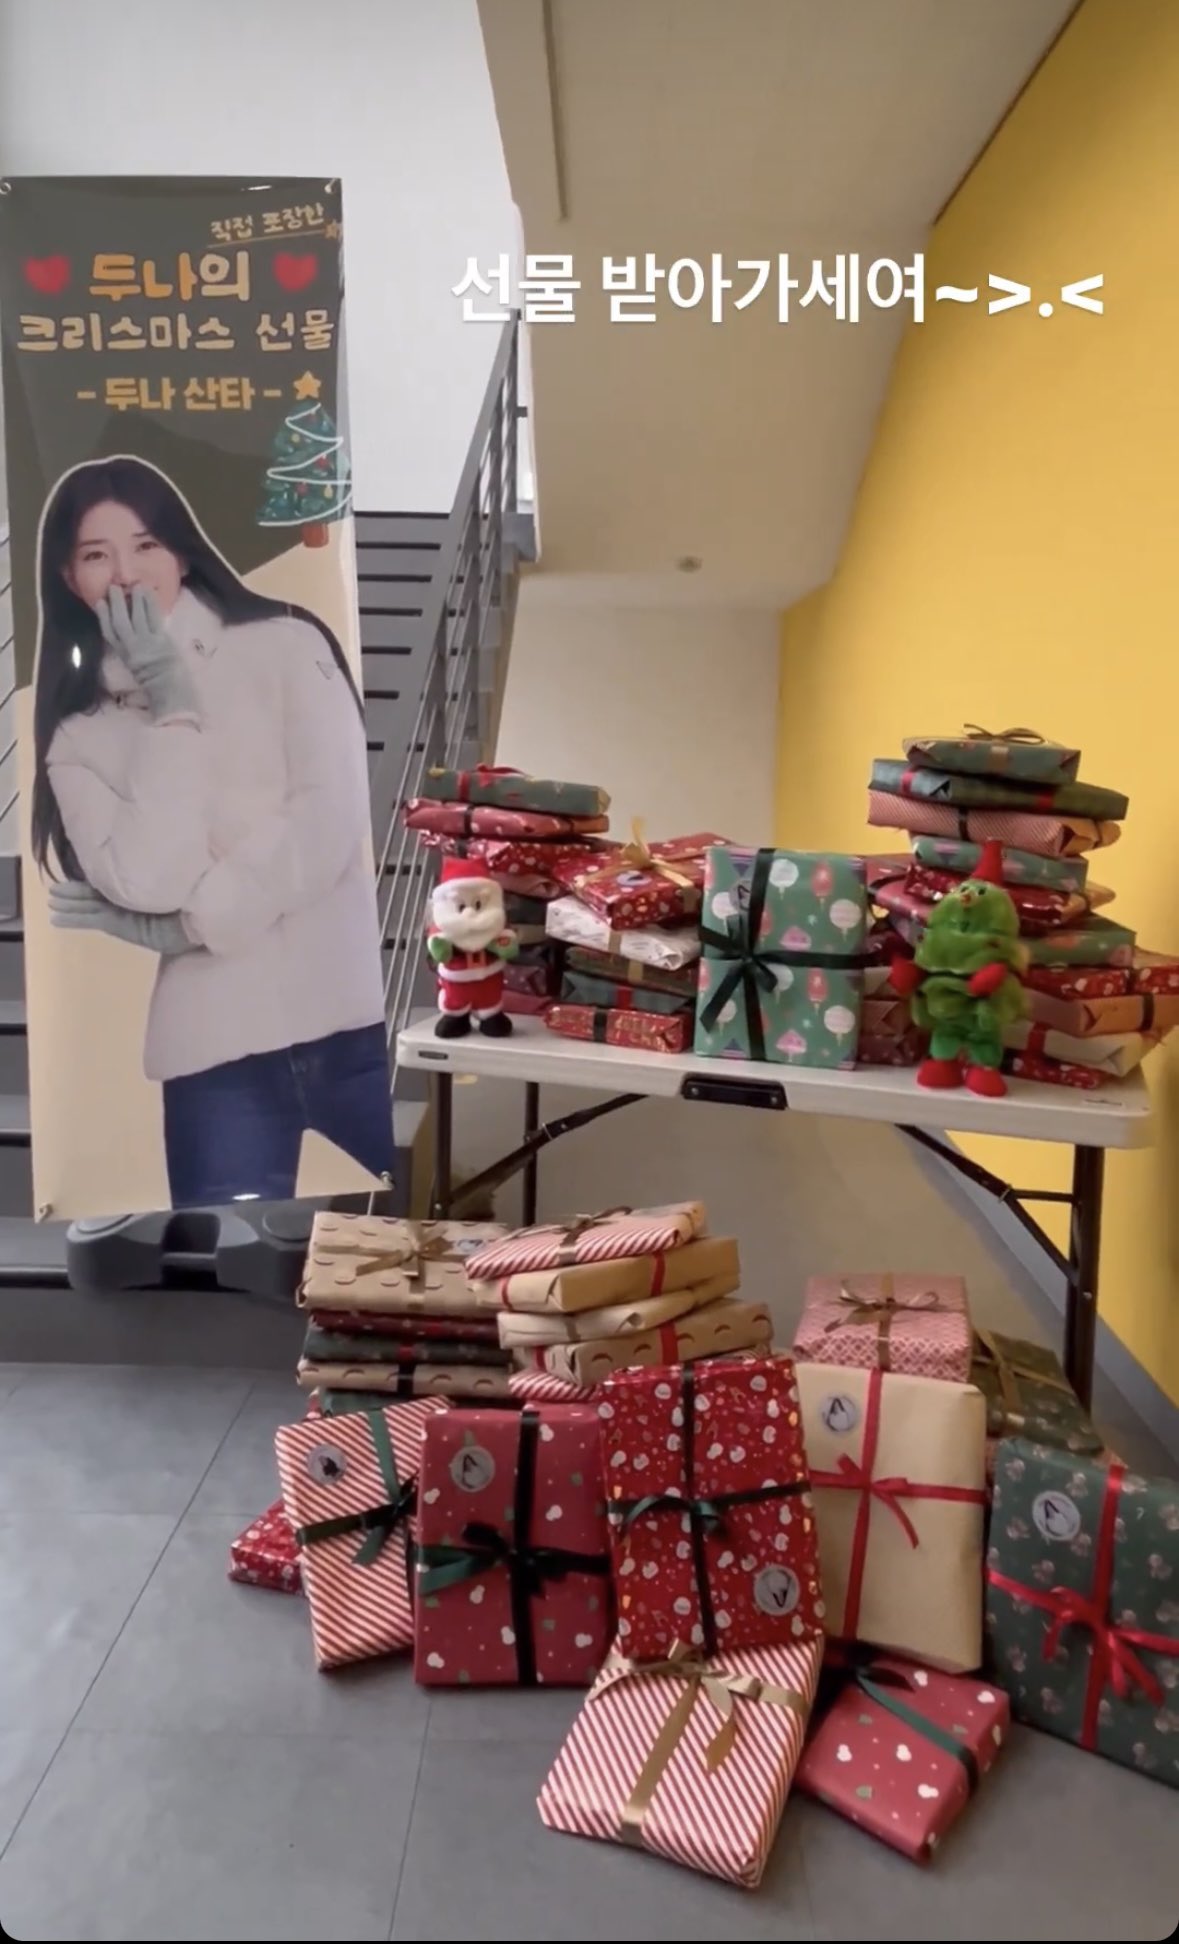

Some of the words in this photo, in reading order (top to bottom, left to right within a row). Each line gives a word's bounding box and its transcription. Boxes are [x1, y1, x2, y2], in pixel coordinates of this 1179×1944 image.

[210, 215, 254, 241] 직접
[261, 202, 325, 233] 포장한
[88, 250, 251, 302] 두나의
[17, 312, 235, 351] 크리스마스
[256, 309, 335, 351] 선물
[104, 377, 176, 411] 두나
[183, 376, 255, 411] 산타
